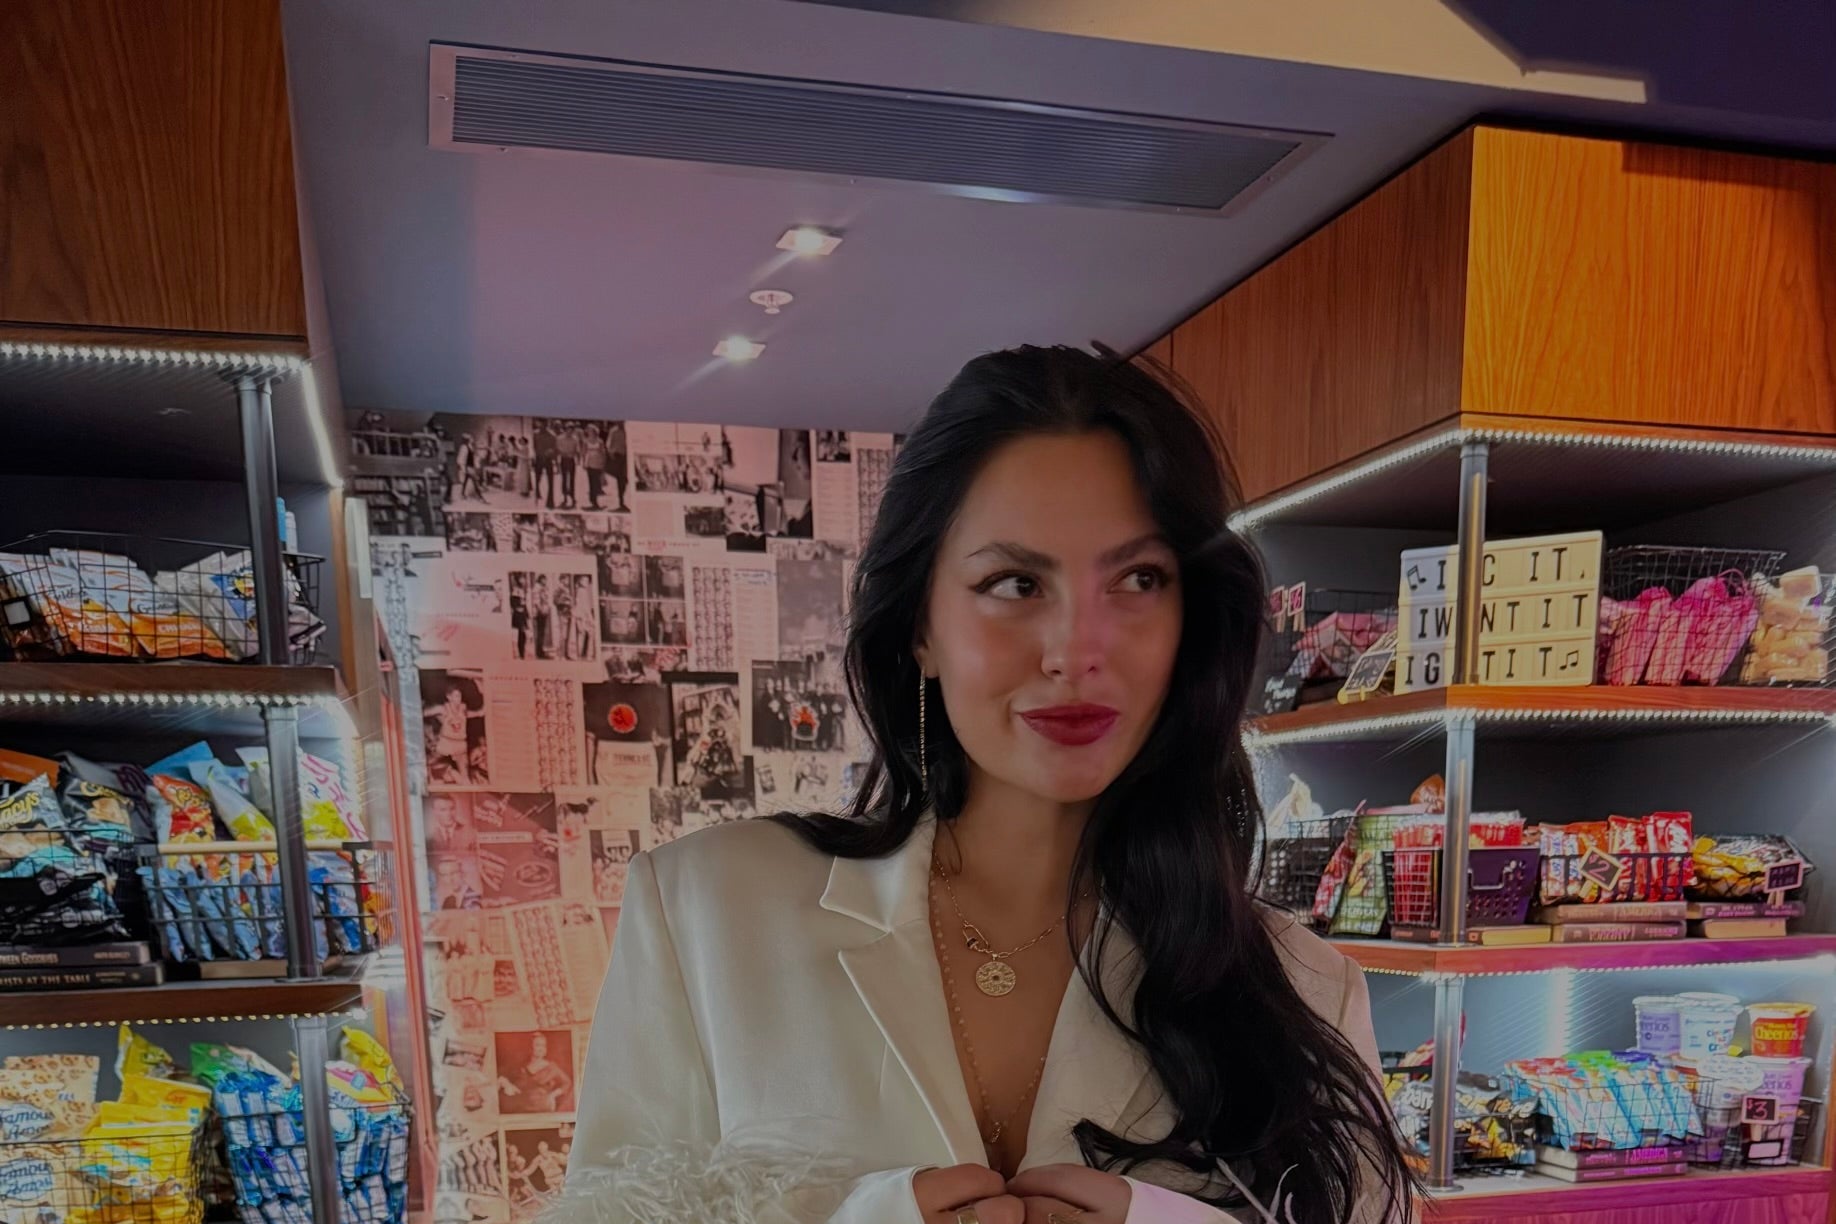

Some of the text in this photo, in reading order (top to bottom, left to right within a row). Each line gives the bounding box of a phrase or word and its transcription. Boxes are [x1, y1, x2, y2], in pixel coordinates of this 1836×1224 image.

[1434, 601, 1520, 638] WNT
[1424, 651, 1496, 686] GT
[1587, 853, 1611, 882] $2
[65, 973, 91, 984] TABLE
[1754, 1025, 1798, 1041] Cheerios
[1746, 1097, 1768, 1120] $3
